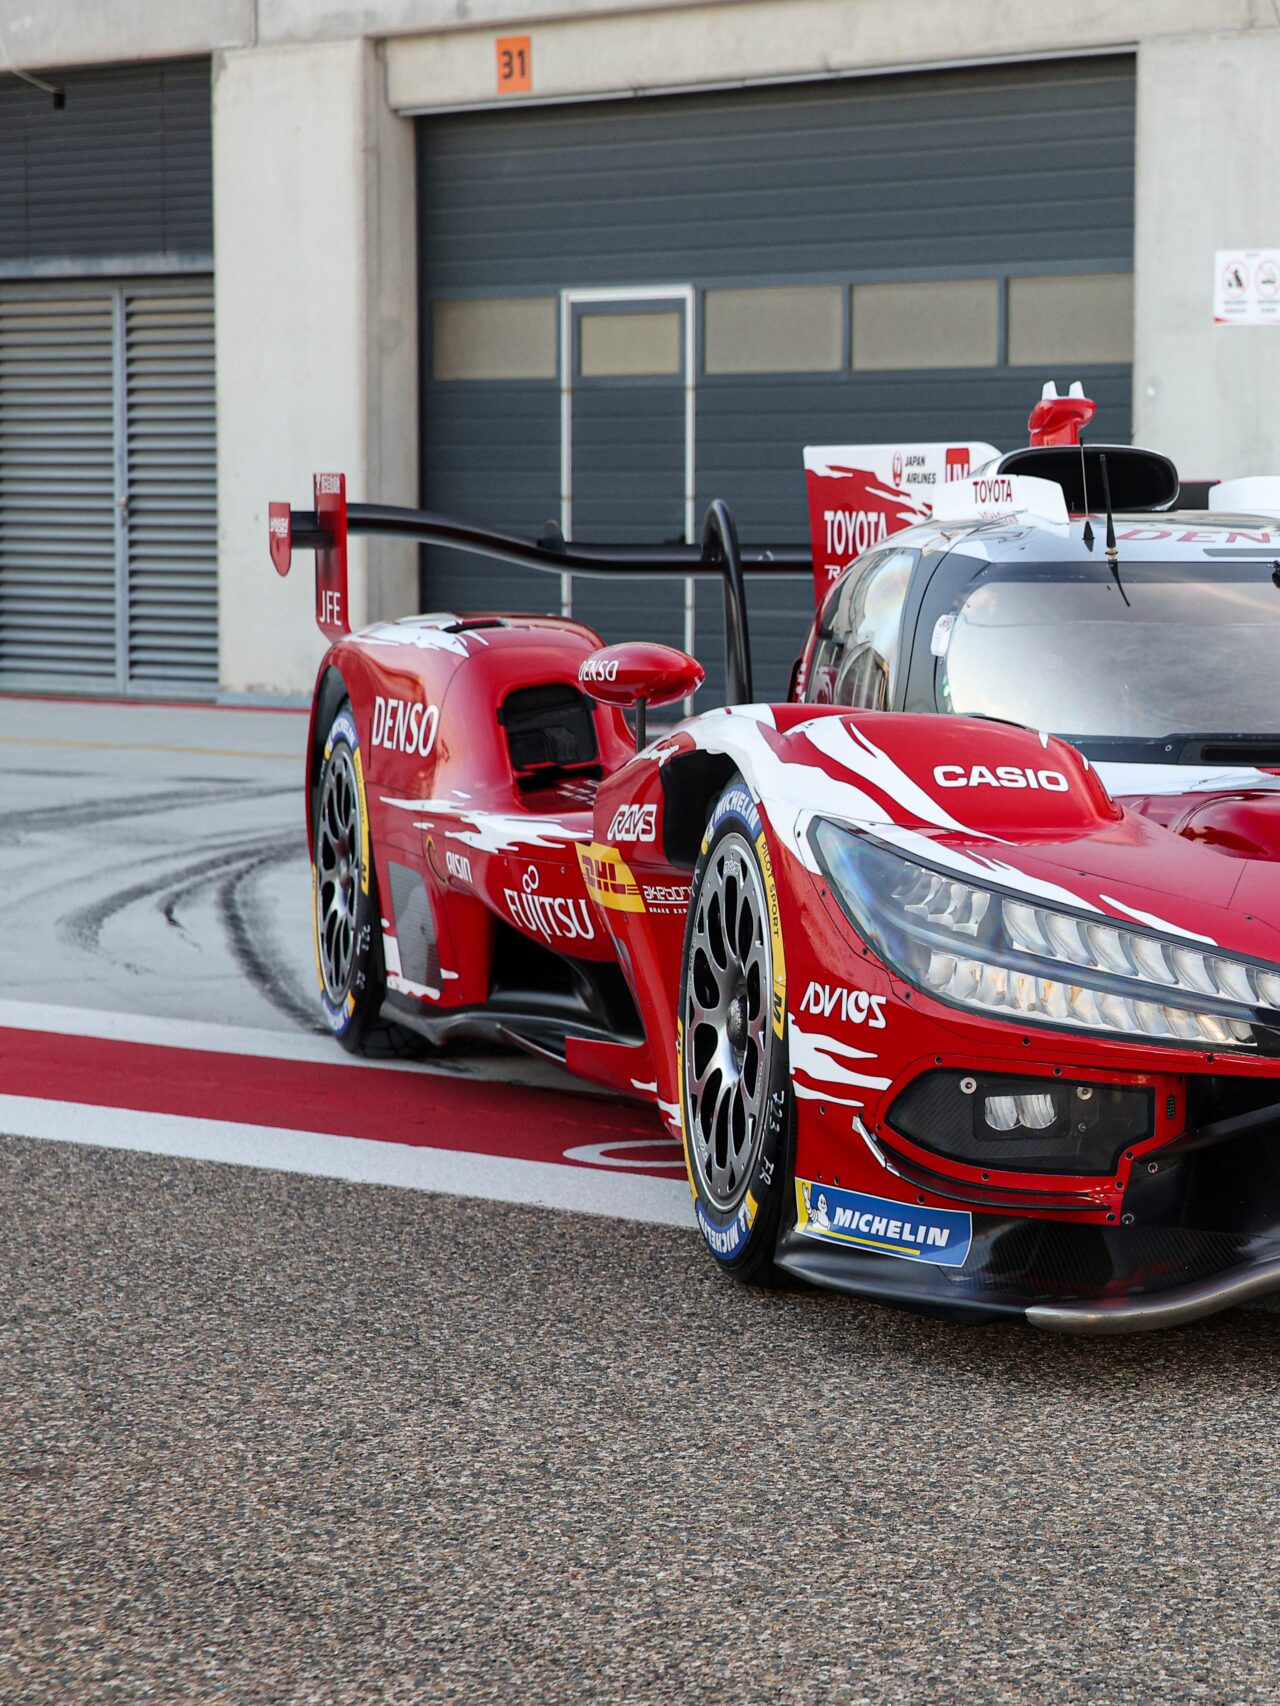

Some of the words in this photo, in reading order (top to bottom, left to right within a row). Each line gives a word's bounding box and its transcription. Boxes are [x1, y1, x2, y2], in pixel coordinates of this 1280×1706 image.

[502, 49, 525, 80] 31
[905, 456, 926, 467] JAPAN
[906, 473, 936, 485] AIRLINES
[972, 479, 1013, 504] TOYOTA
[824, 510, 887, 555] TOYOTA
[320, 590, 342, 626] JFE
[578, 660, 619, 681] DENSO
[372, 696, 439, 757] DENSO
[933, 765, 1069, 792] CASIO
[607, 804, 657, 842] RAYS
[714, 790, 760, 831] MICHELIN
[582, 855, 626, 895] DHL
[761, 841, 775, 878] PILOT
[642, 886, 694, 901] akebon
[769, 884, 780, 938] SPORT
[503, 888, 595, 943] FUJITSU
[833, 1207, 949, 1248] MICHELIN
